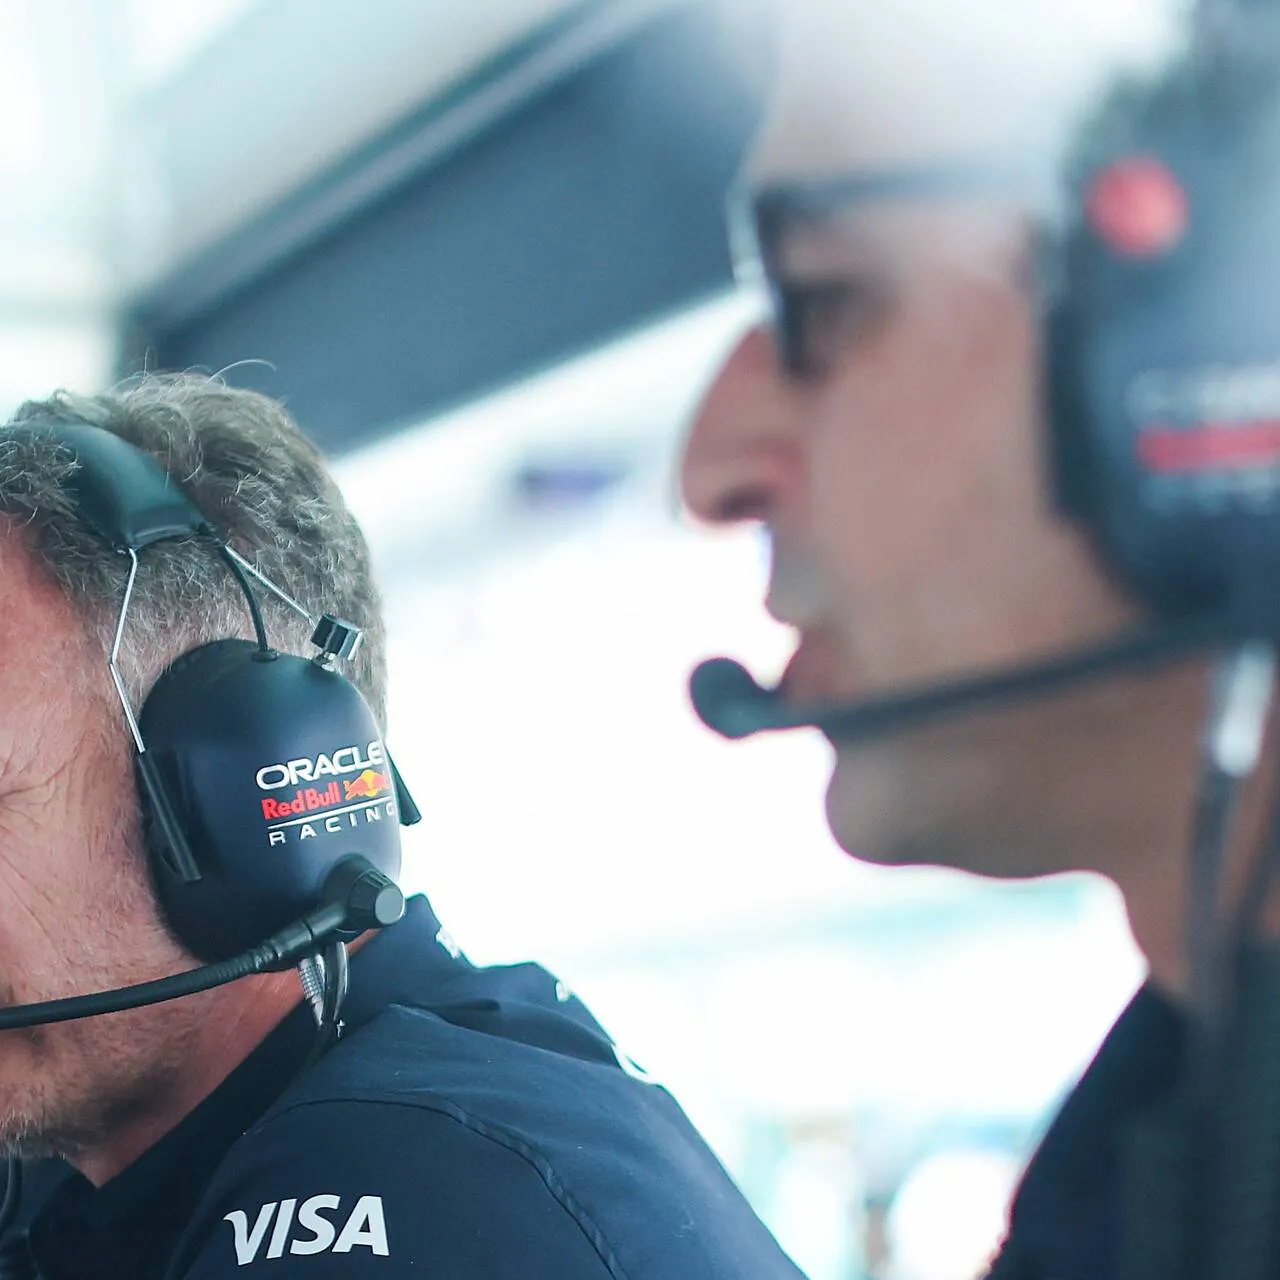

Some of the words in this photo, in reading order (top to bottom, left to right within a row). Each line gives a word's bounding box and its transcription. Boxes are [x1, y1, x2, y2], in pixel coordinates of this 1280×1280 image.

[256, 740, 385, 790] ORACLE
[261, 790, 304, 820] Red
[305, 781, 342, 811] Bull
[268, 802, 396, 847] RACING
[223, 1194, 389, 1266] VISA
